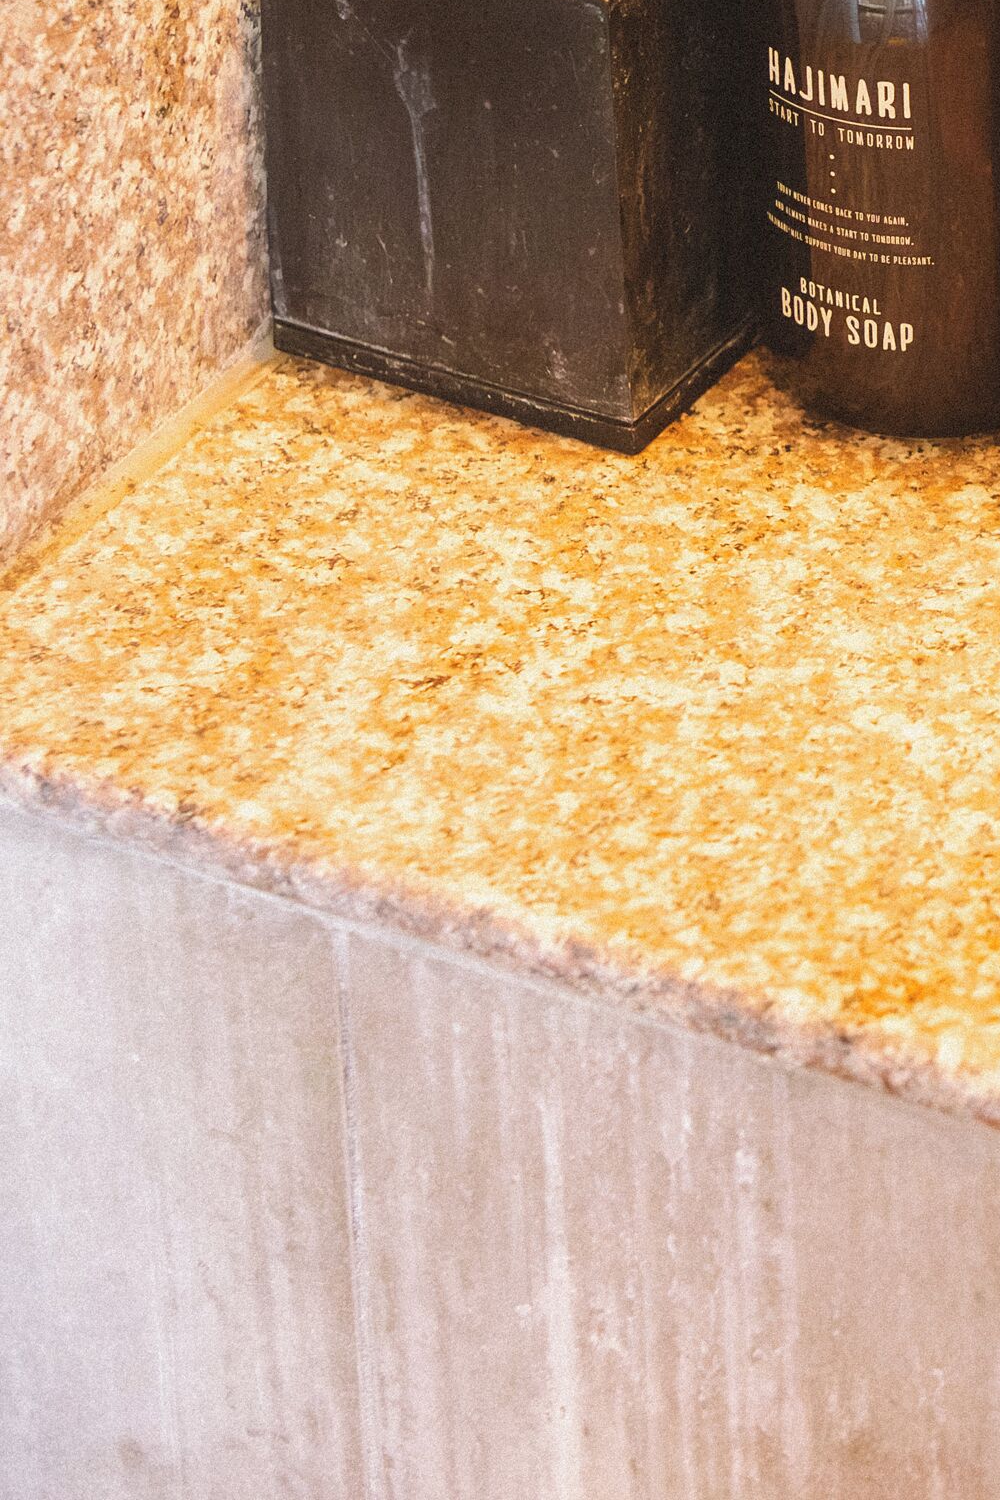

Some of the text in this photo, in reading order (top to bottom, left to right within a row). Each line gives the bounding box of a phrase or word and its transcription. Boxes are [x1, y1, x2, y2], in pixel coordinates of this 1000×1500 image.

[769, 47, 911, 119] HAJIMARI
[769, 98, 914, 150] START TO TOMORROW
[776, 200, 784, 212] AND
[786, 207, 806, 223] ALWAYS
[808, 218, 827, 232] MAKES
[830, 225, 834, 233] A
[837, 227, 857, 240] START
[860, 233, 869, 242] TO
[793, 189, 811, 207] NEVER
[813, 199, 833, 214] COMES
[835, 207, 852, 218] BACK
[855, 212, 864, 221] TO
[867, 214, 880, 223] YOU
[791, 229, 802, 242] WILL
[805, 235, 831, 252] SUPPORT
[834, 246, 850, 258] YOUR
[853, 251, 867, 261] DAY
[870, 253, 878, 262] TO
[881, 255, 890, 264] BE
[800, 277, 881, 315] BOTANICAL
[782, 287, 914, 352] BODY SOAP
